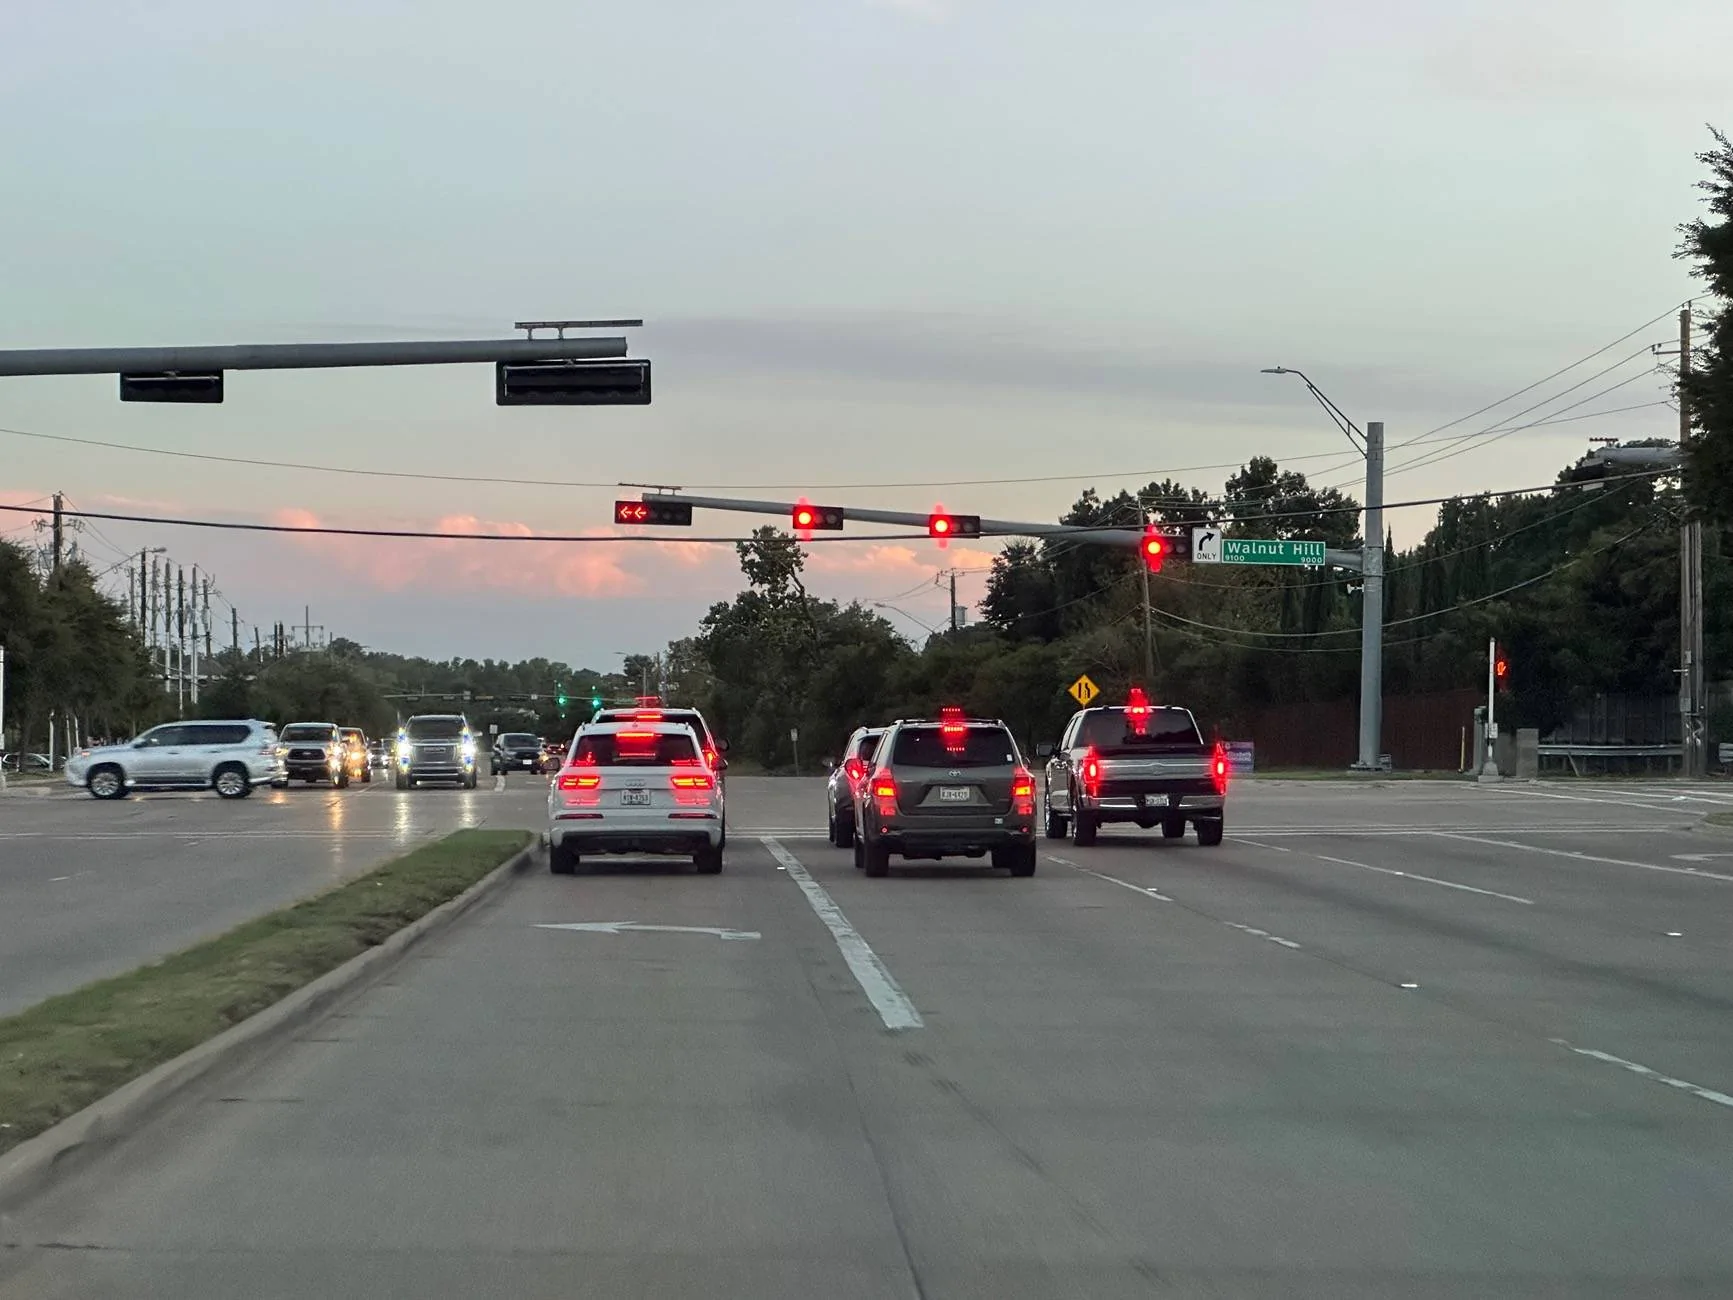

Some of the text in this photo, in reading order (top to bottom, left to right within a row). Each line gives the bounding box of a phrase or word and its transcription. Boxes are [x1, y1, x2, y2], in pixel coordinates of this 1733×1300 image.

[1227, 542, 1320, 556] Walnut Hill
[1196, 552, 1216, 560] ONLY
